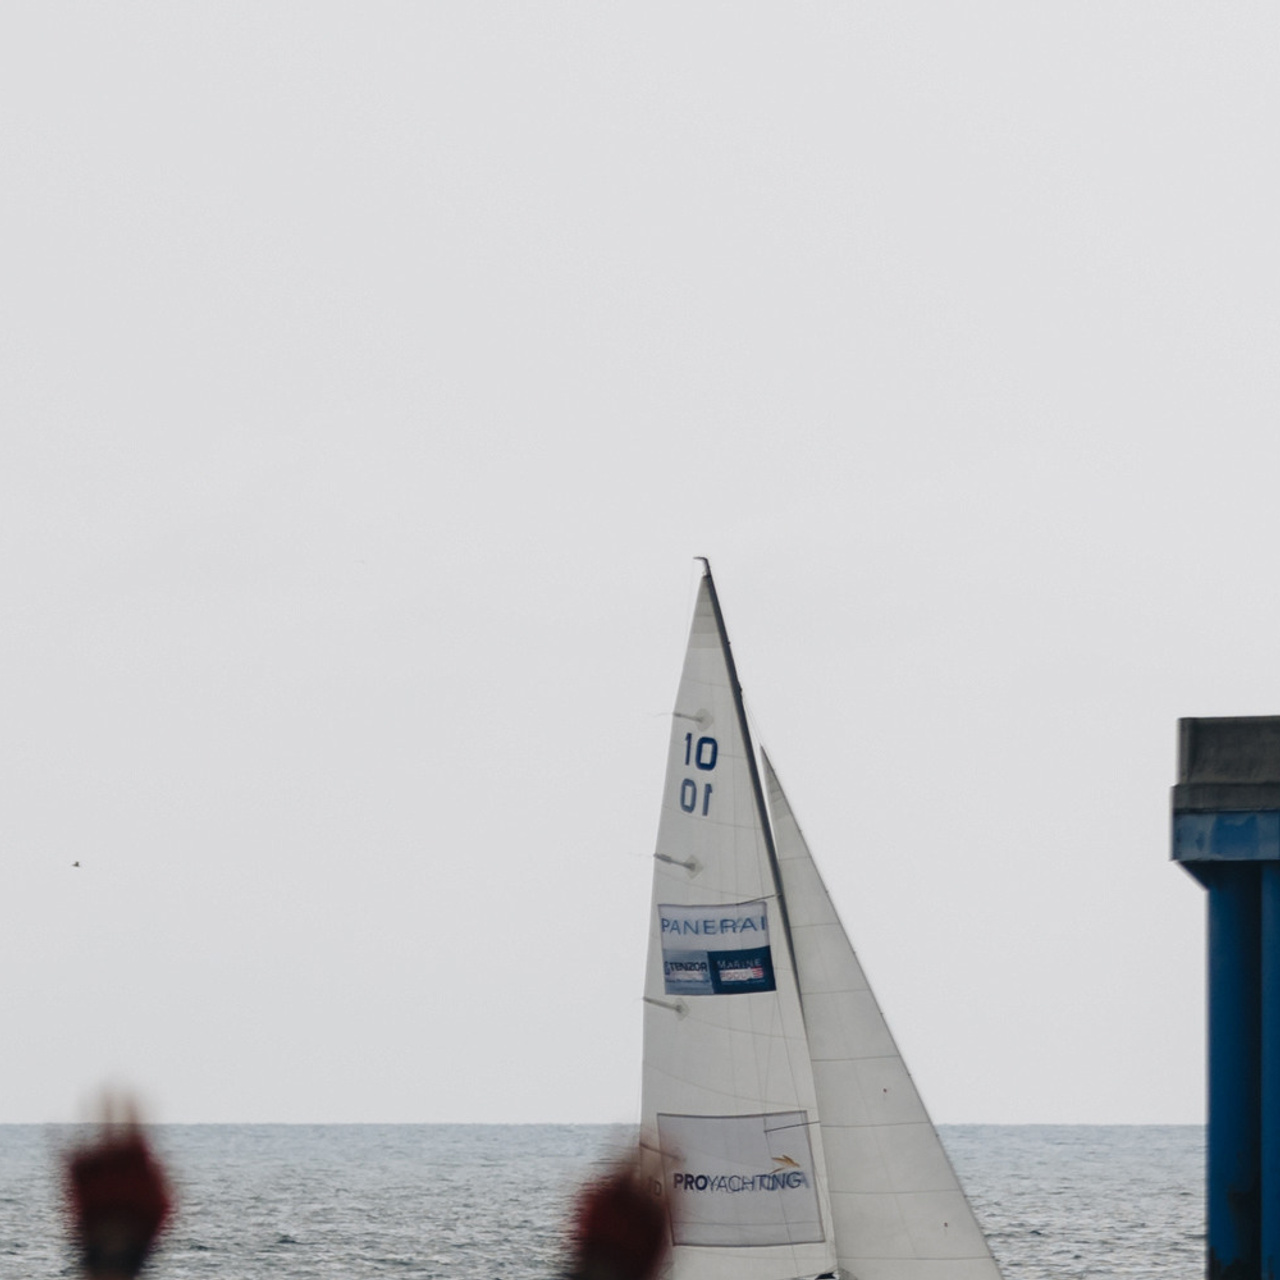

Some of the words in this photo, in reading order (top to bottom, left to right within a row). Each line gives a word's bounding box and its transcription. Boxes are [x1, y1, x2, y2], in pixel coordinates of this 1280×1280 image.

[684, 732, 718, 771] 10
[661, 915, 766, 935] PANERAI
[673, 1171, 804, 1192] PROYACHTING
